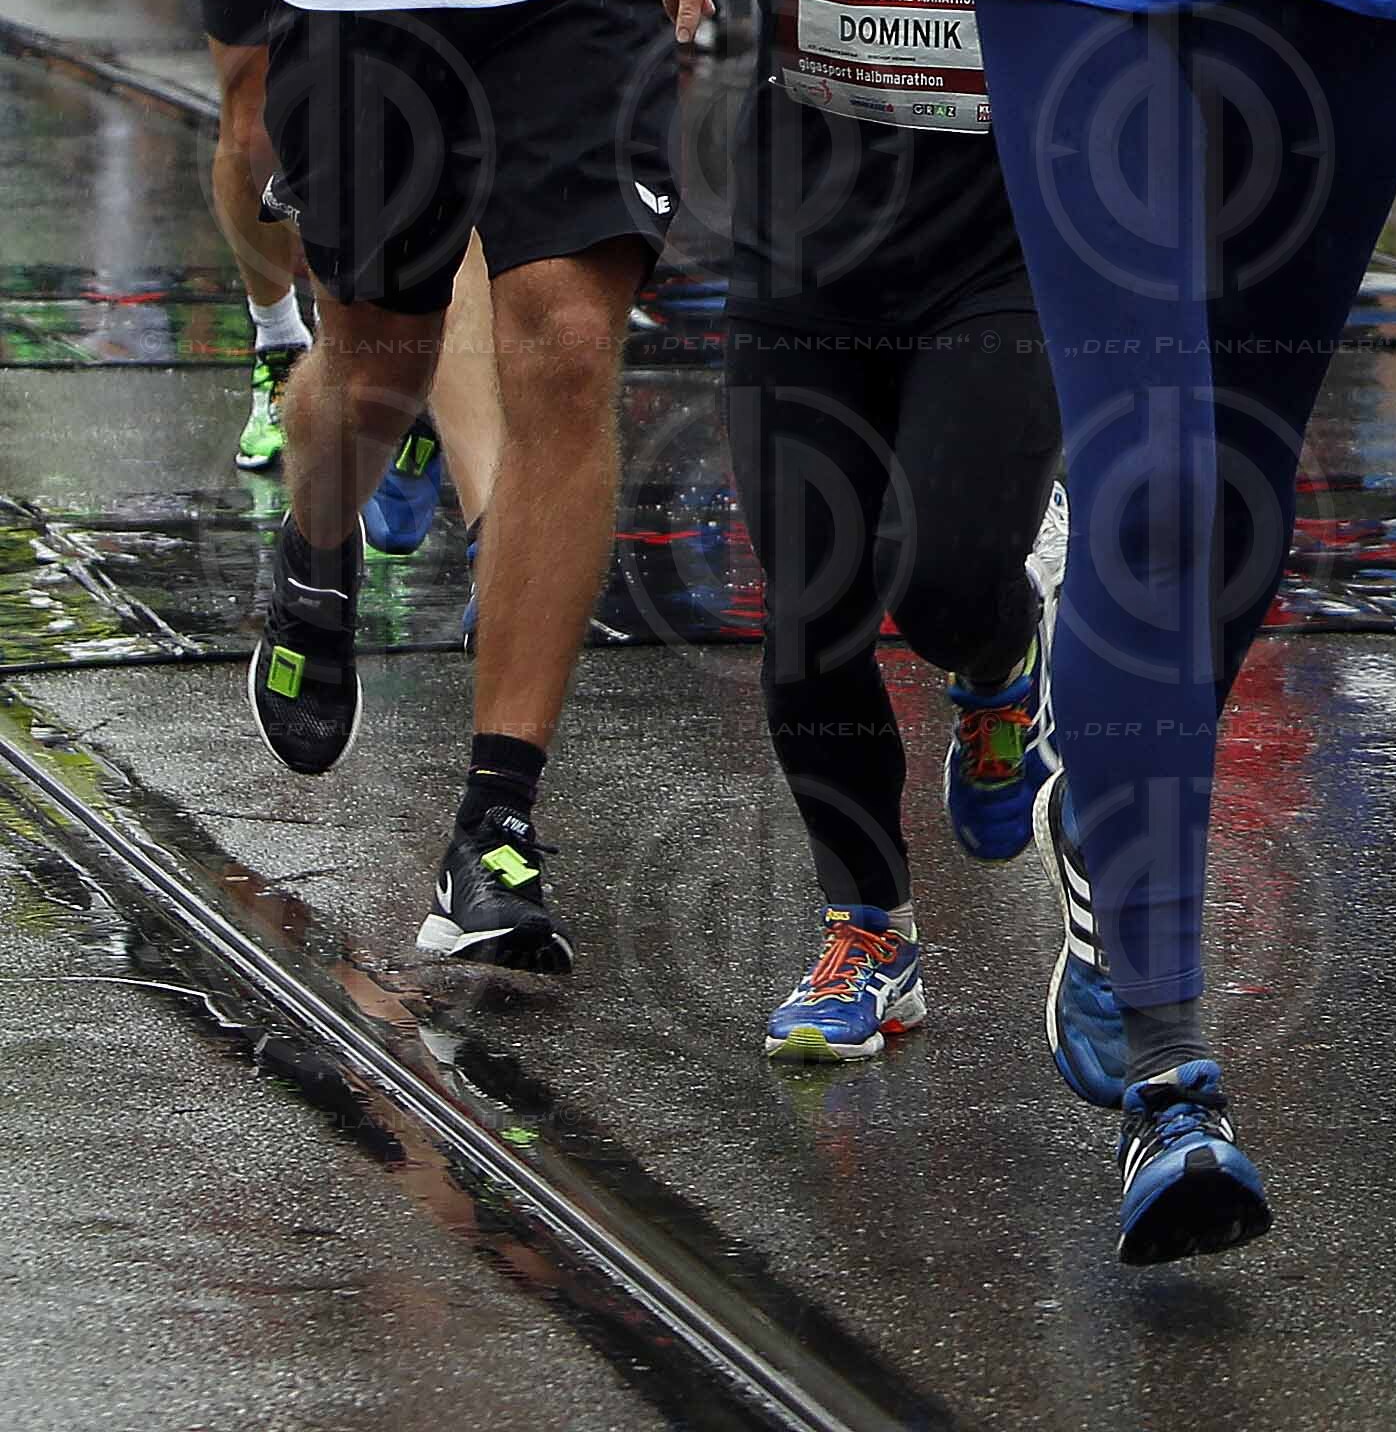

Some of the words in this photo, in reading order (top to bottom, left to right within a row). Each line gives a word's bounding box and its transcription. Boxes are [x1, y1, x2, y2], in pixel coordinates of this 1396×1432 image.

[839, 14, 962, 49] DOMINIK
[798, 57, 853, 79] gigasport
[855, 68, 944, 87] Halbmarathon
[912, 103, 957, 117] GRAZ
